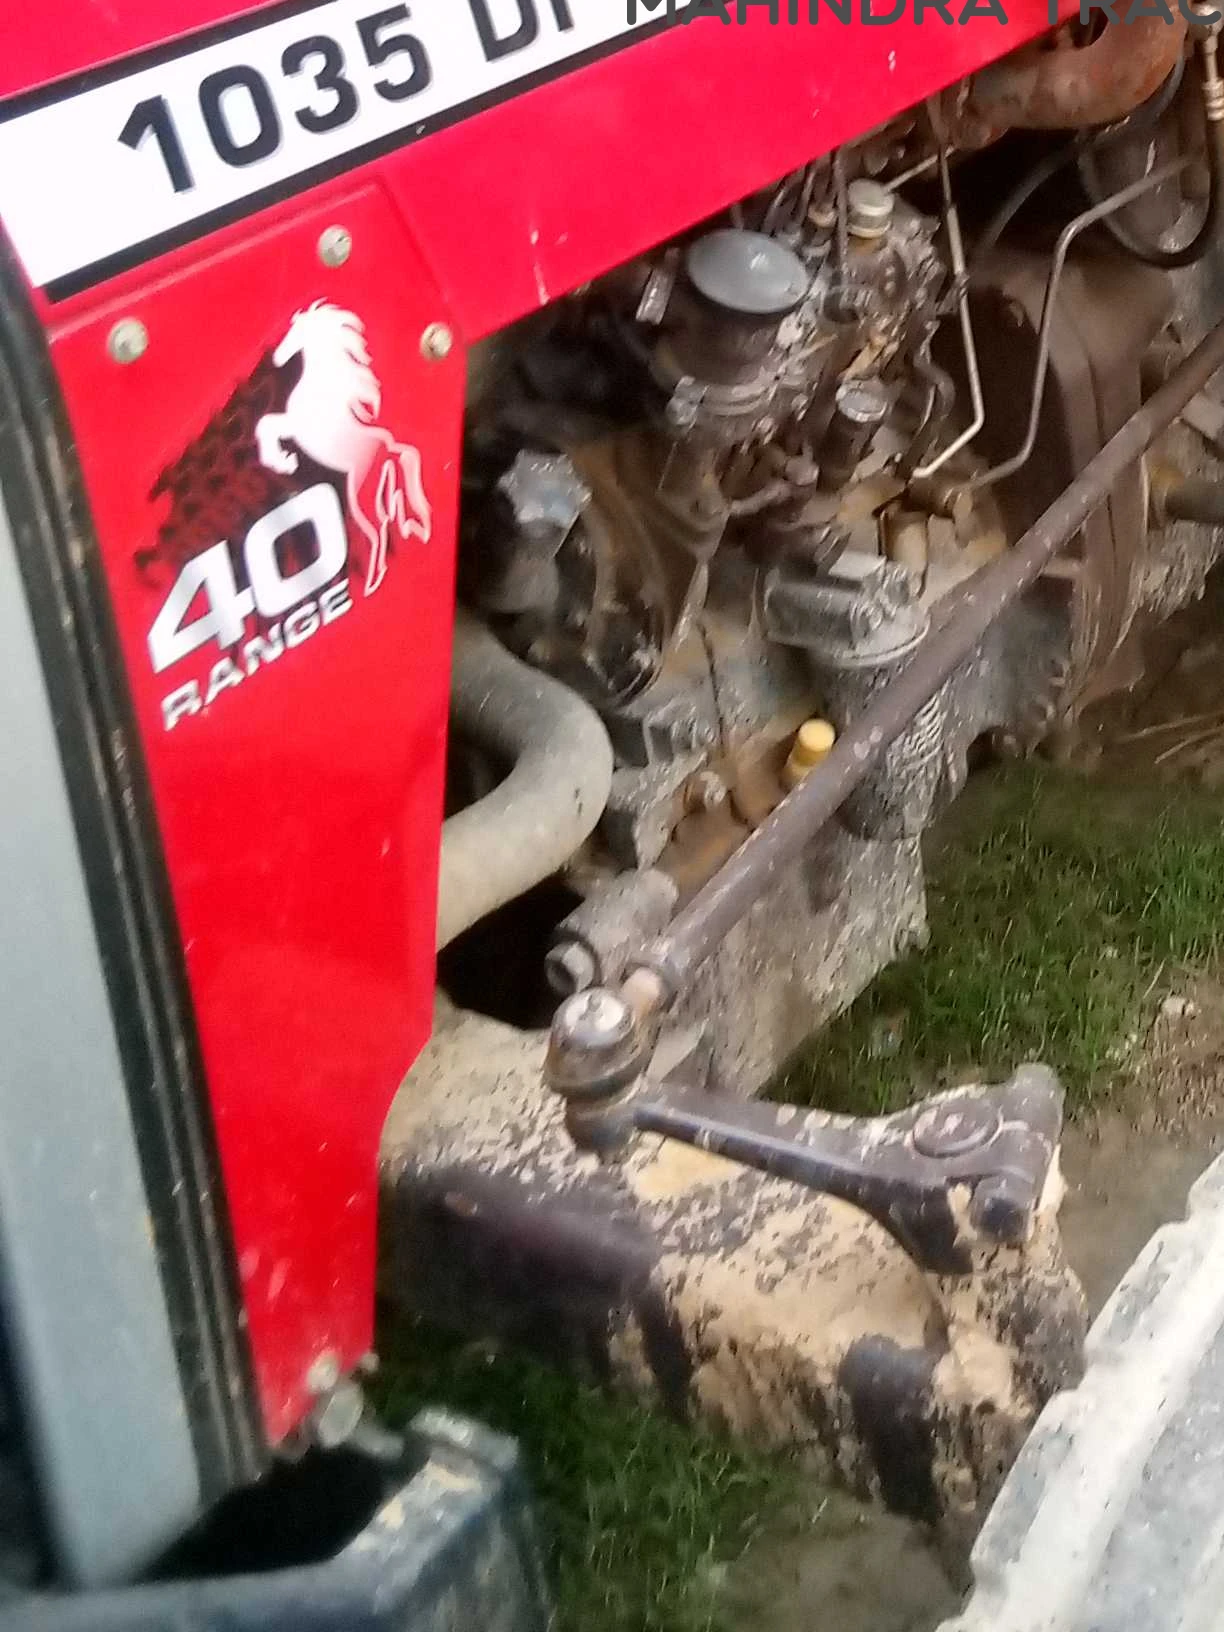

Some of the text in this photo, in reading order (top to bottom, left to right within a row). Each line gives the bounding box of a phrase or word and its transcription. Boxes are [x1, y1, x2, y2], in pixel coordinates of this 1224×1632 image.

[117, 3, 433, 193] 1035
[147, 481, 350, 674] 40
[160, 578, 353, 732] RANGE
